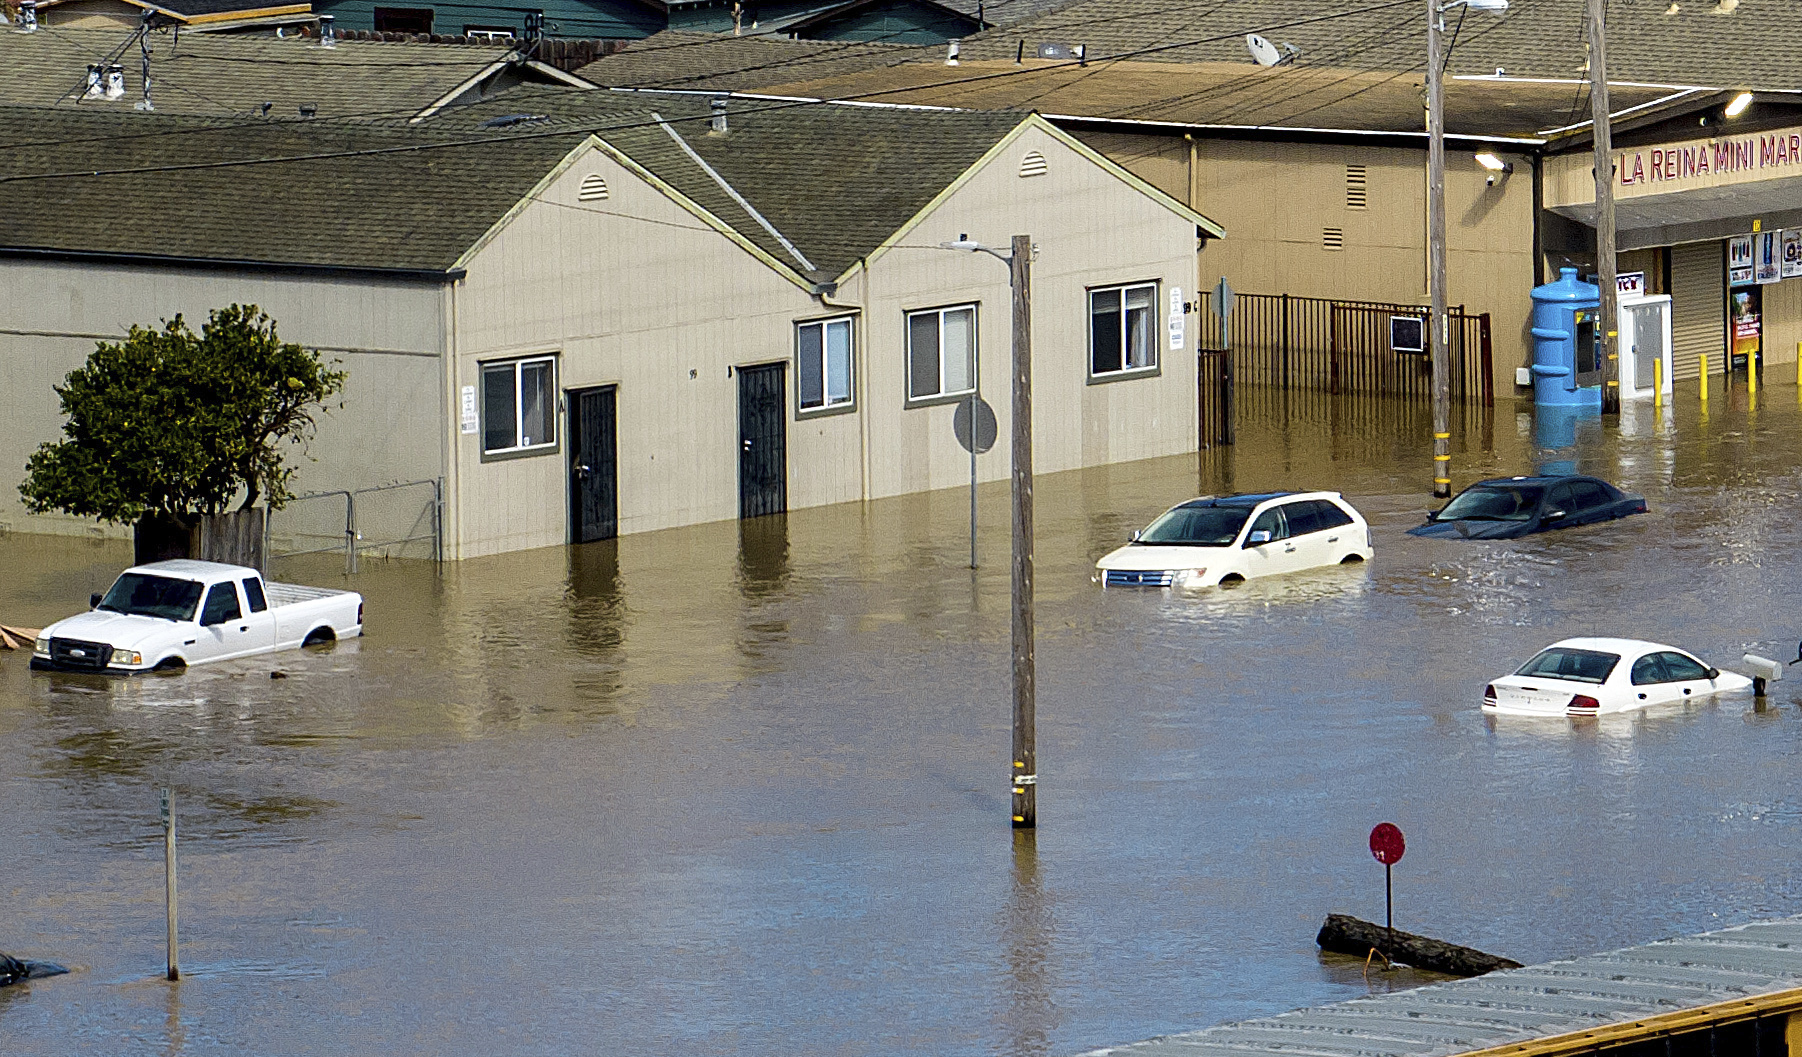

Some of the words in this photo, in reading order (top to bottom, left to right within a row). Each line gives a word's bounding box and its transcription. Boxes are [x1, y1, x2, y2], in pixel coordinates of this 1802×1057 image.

[1620, 151, 1645, 186] LA
[1650, 144, 1710, 183] REINA
[1714, 139, 1754, 175] MINI
